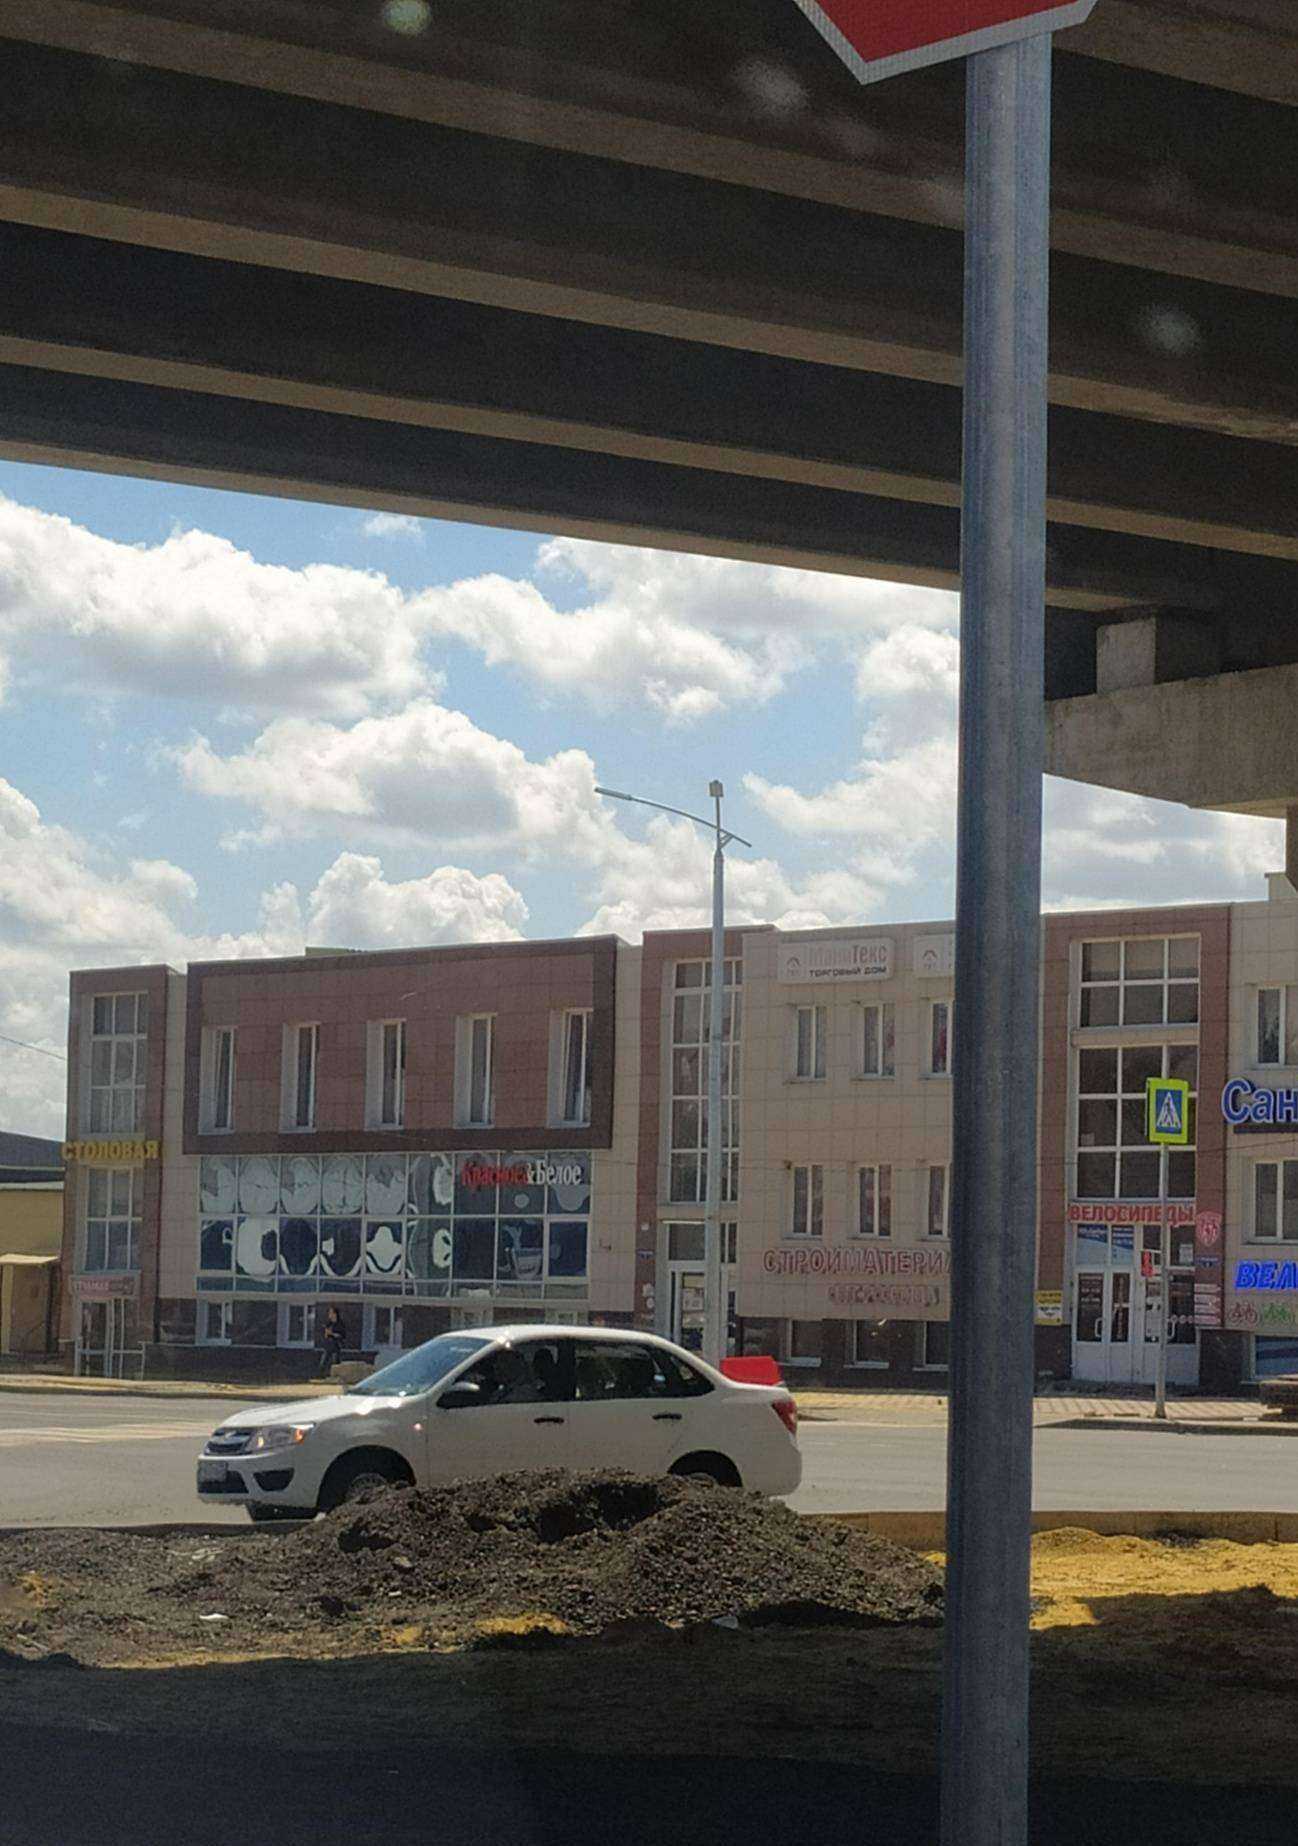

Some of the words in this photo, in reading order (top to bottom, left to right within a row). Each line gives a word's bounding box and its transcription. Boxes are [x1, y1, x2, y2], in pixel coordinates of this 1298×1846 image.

[1221, 1077, 1298, 1124] Сан
[61, 1141, 160, 1160] СТОЛОВАЯ
[1069, 1204, 1195, 1225] ВЕЛОСИПЕДЫ
[763, 1246, 952, 1275] СТРОЙМАТЕРИ
